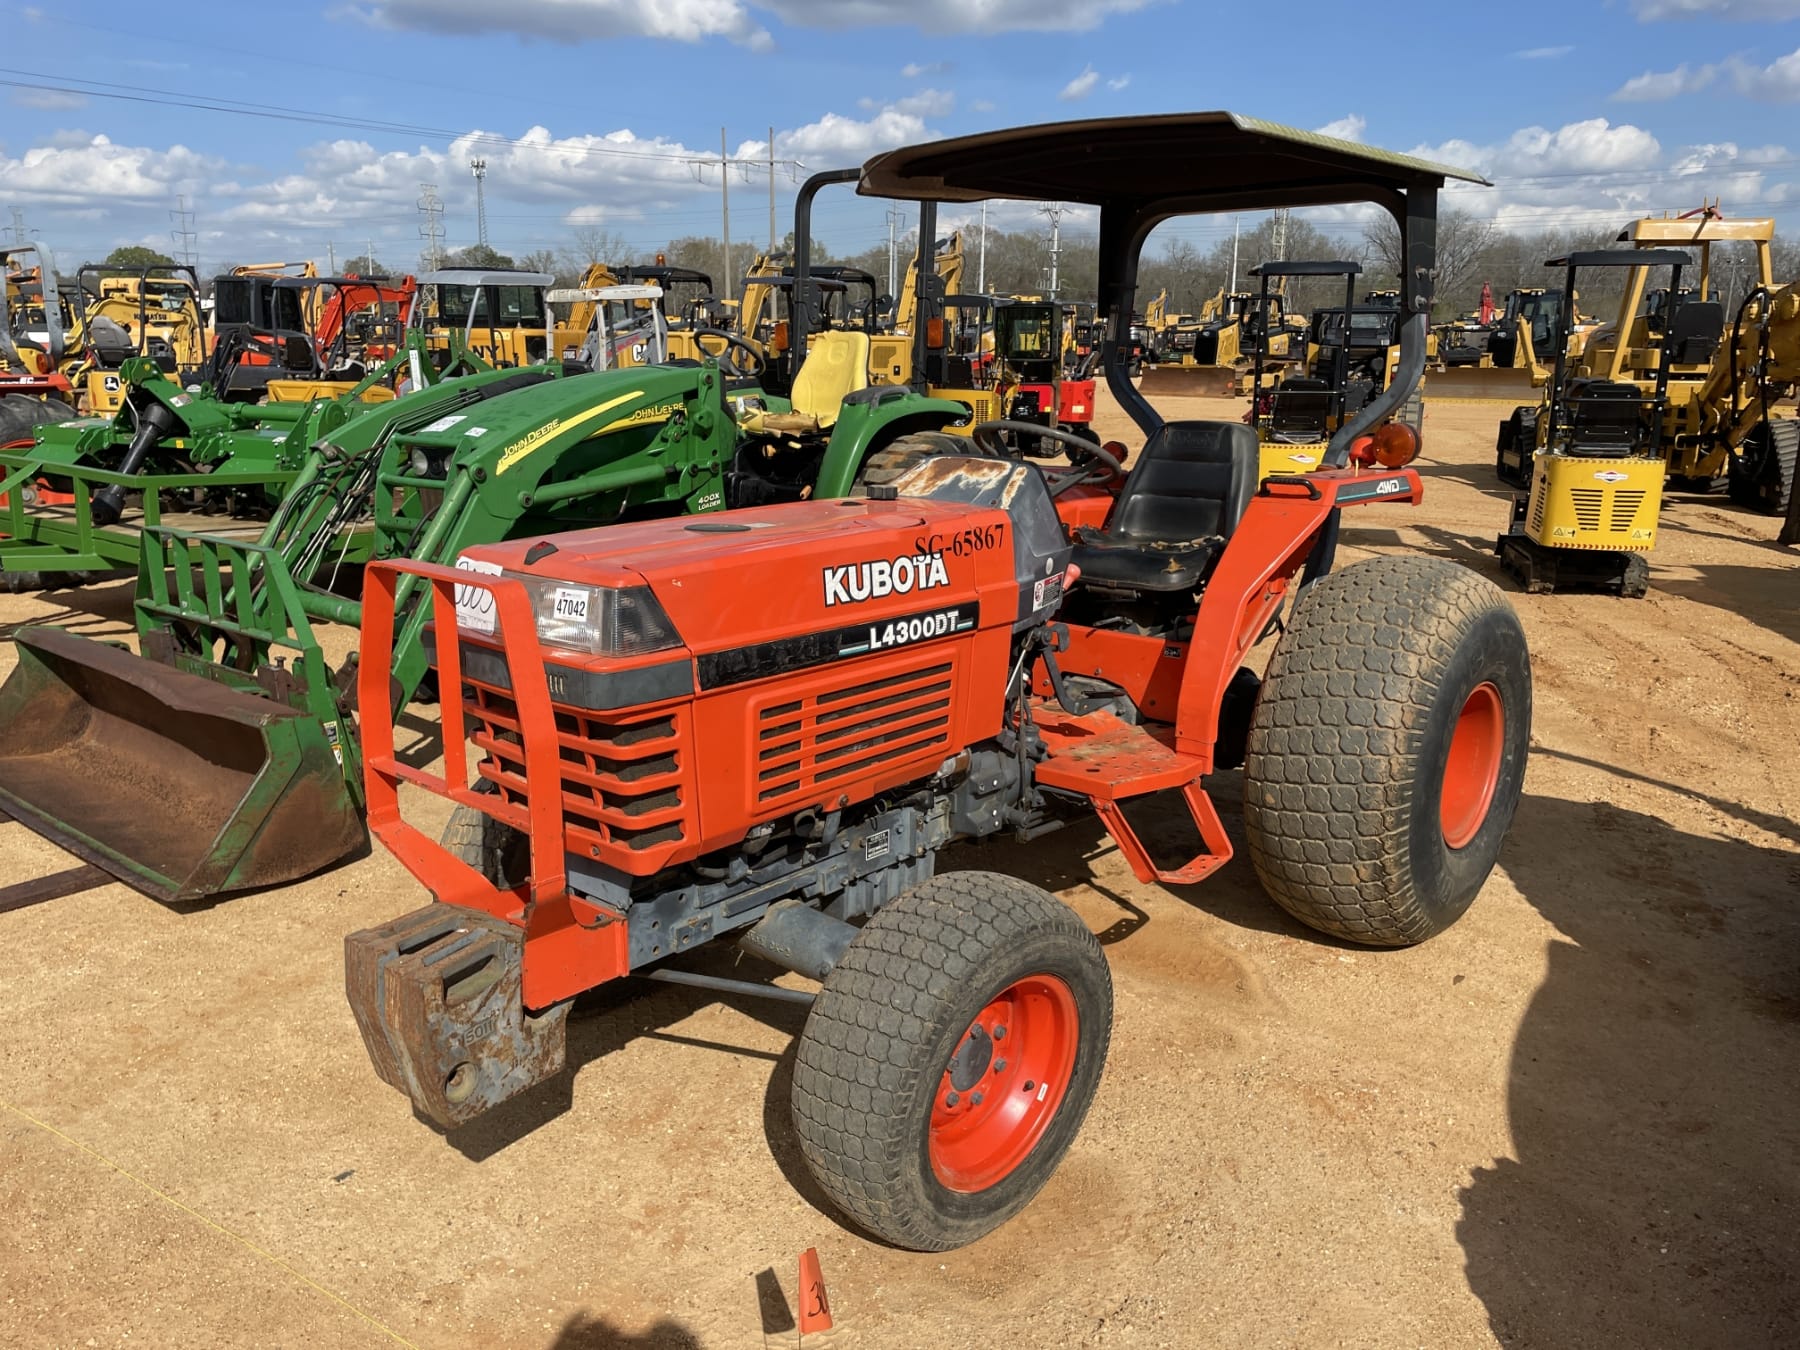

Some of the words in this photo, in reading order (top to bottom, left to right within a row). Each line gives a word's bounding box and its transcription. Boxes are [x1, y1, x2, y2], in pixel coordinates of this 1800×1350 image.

[502, 434, 528, 460] JOHN
[526, 418, 561, 444] DEERE
[698, 492, 720, 504] 400X
[1376, 479, 1400, 494] 4WD
[698, 499, 721, 511] LOADER
[914, 523, 1005, 563] SG-65867
[823, 551, 950, 607] KUBOTA
[556, 598, 586, 617] 47042
[869, 609, 959, 650] L4300DT
